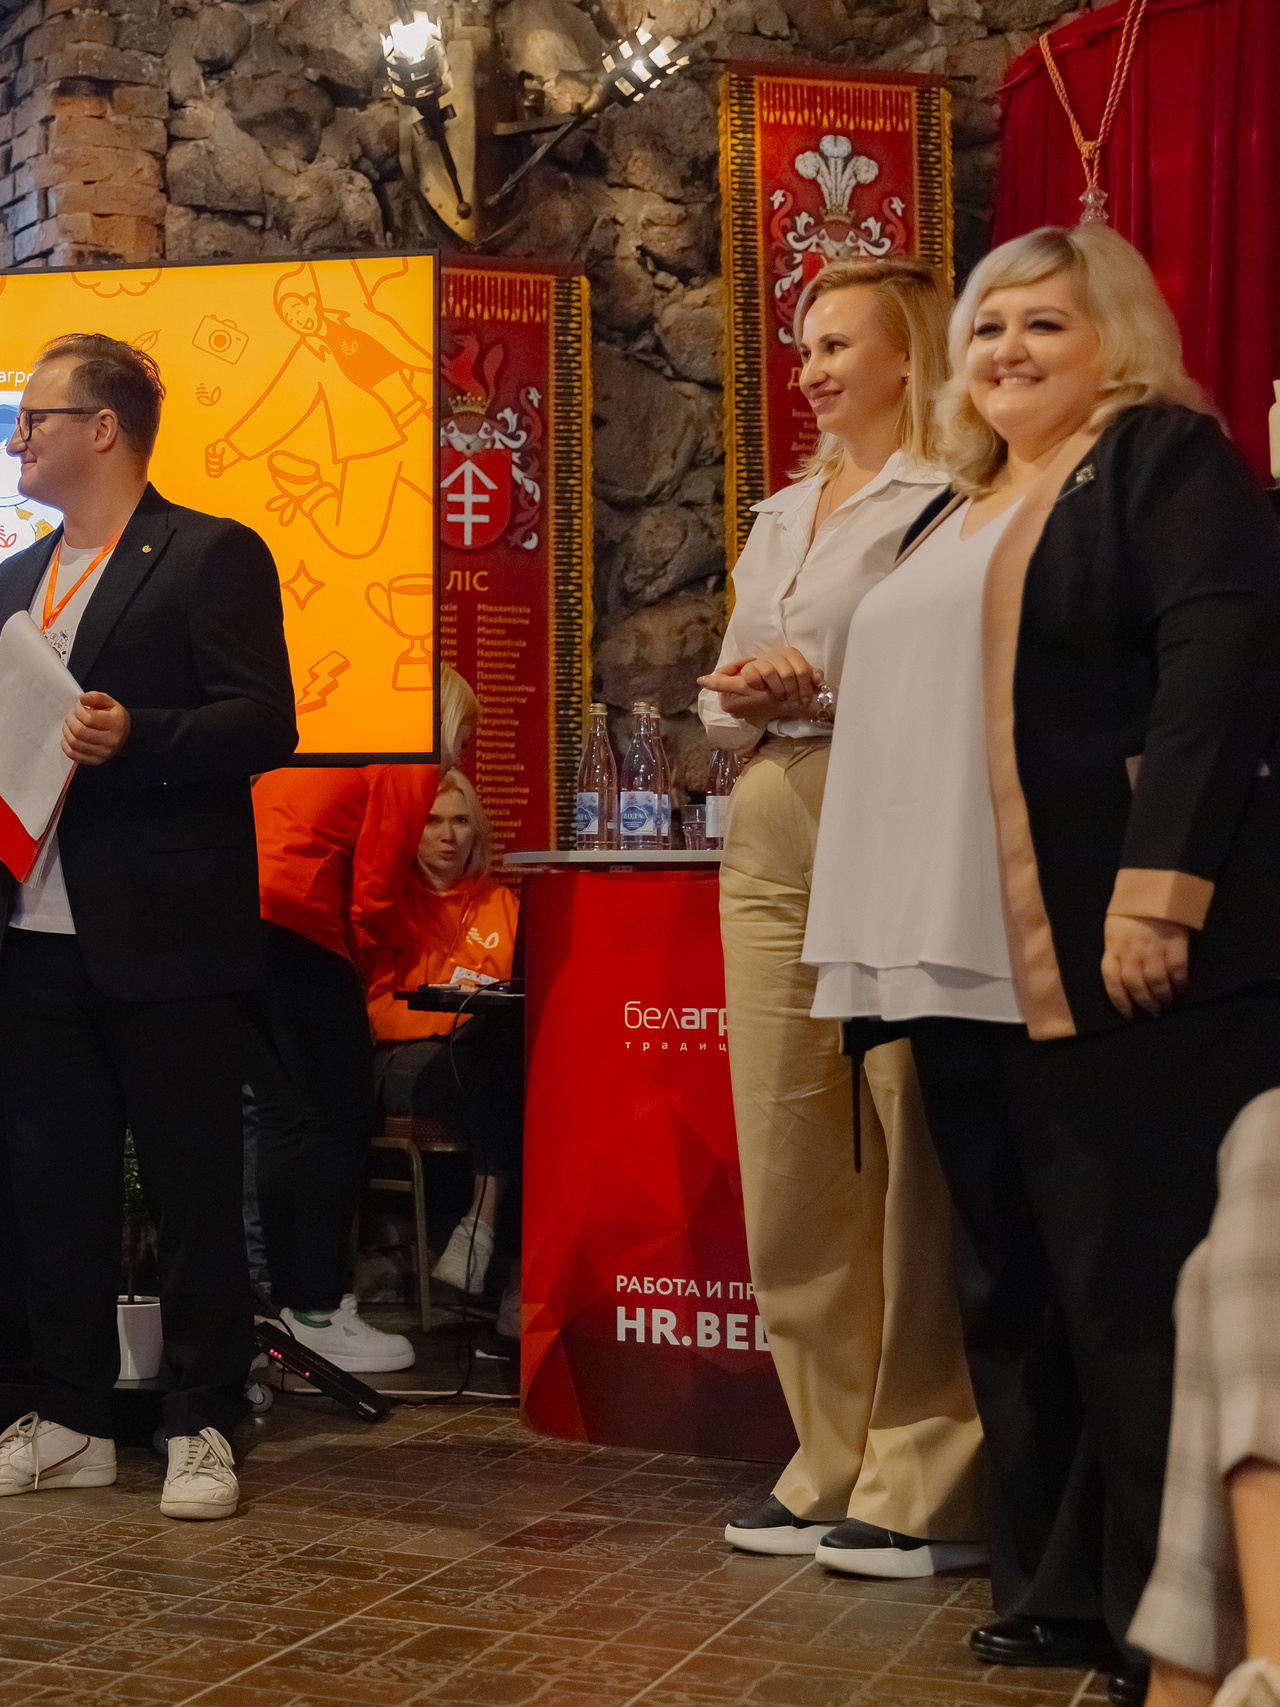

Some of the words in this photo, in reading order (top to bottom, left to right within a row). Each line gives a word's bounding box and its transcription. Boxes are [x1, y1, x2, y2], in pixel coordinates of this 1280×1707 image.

[445, 570, 489, 592] ЛІС
[616, 1274, 701, 1298] РАБОТА
[706, 1280, 721, 1299] И
